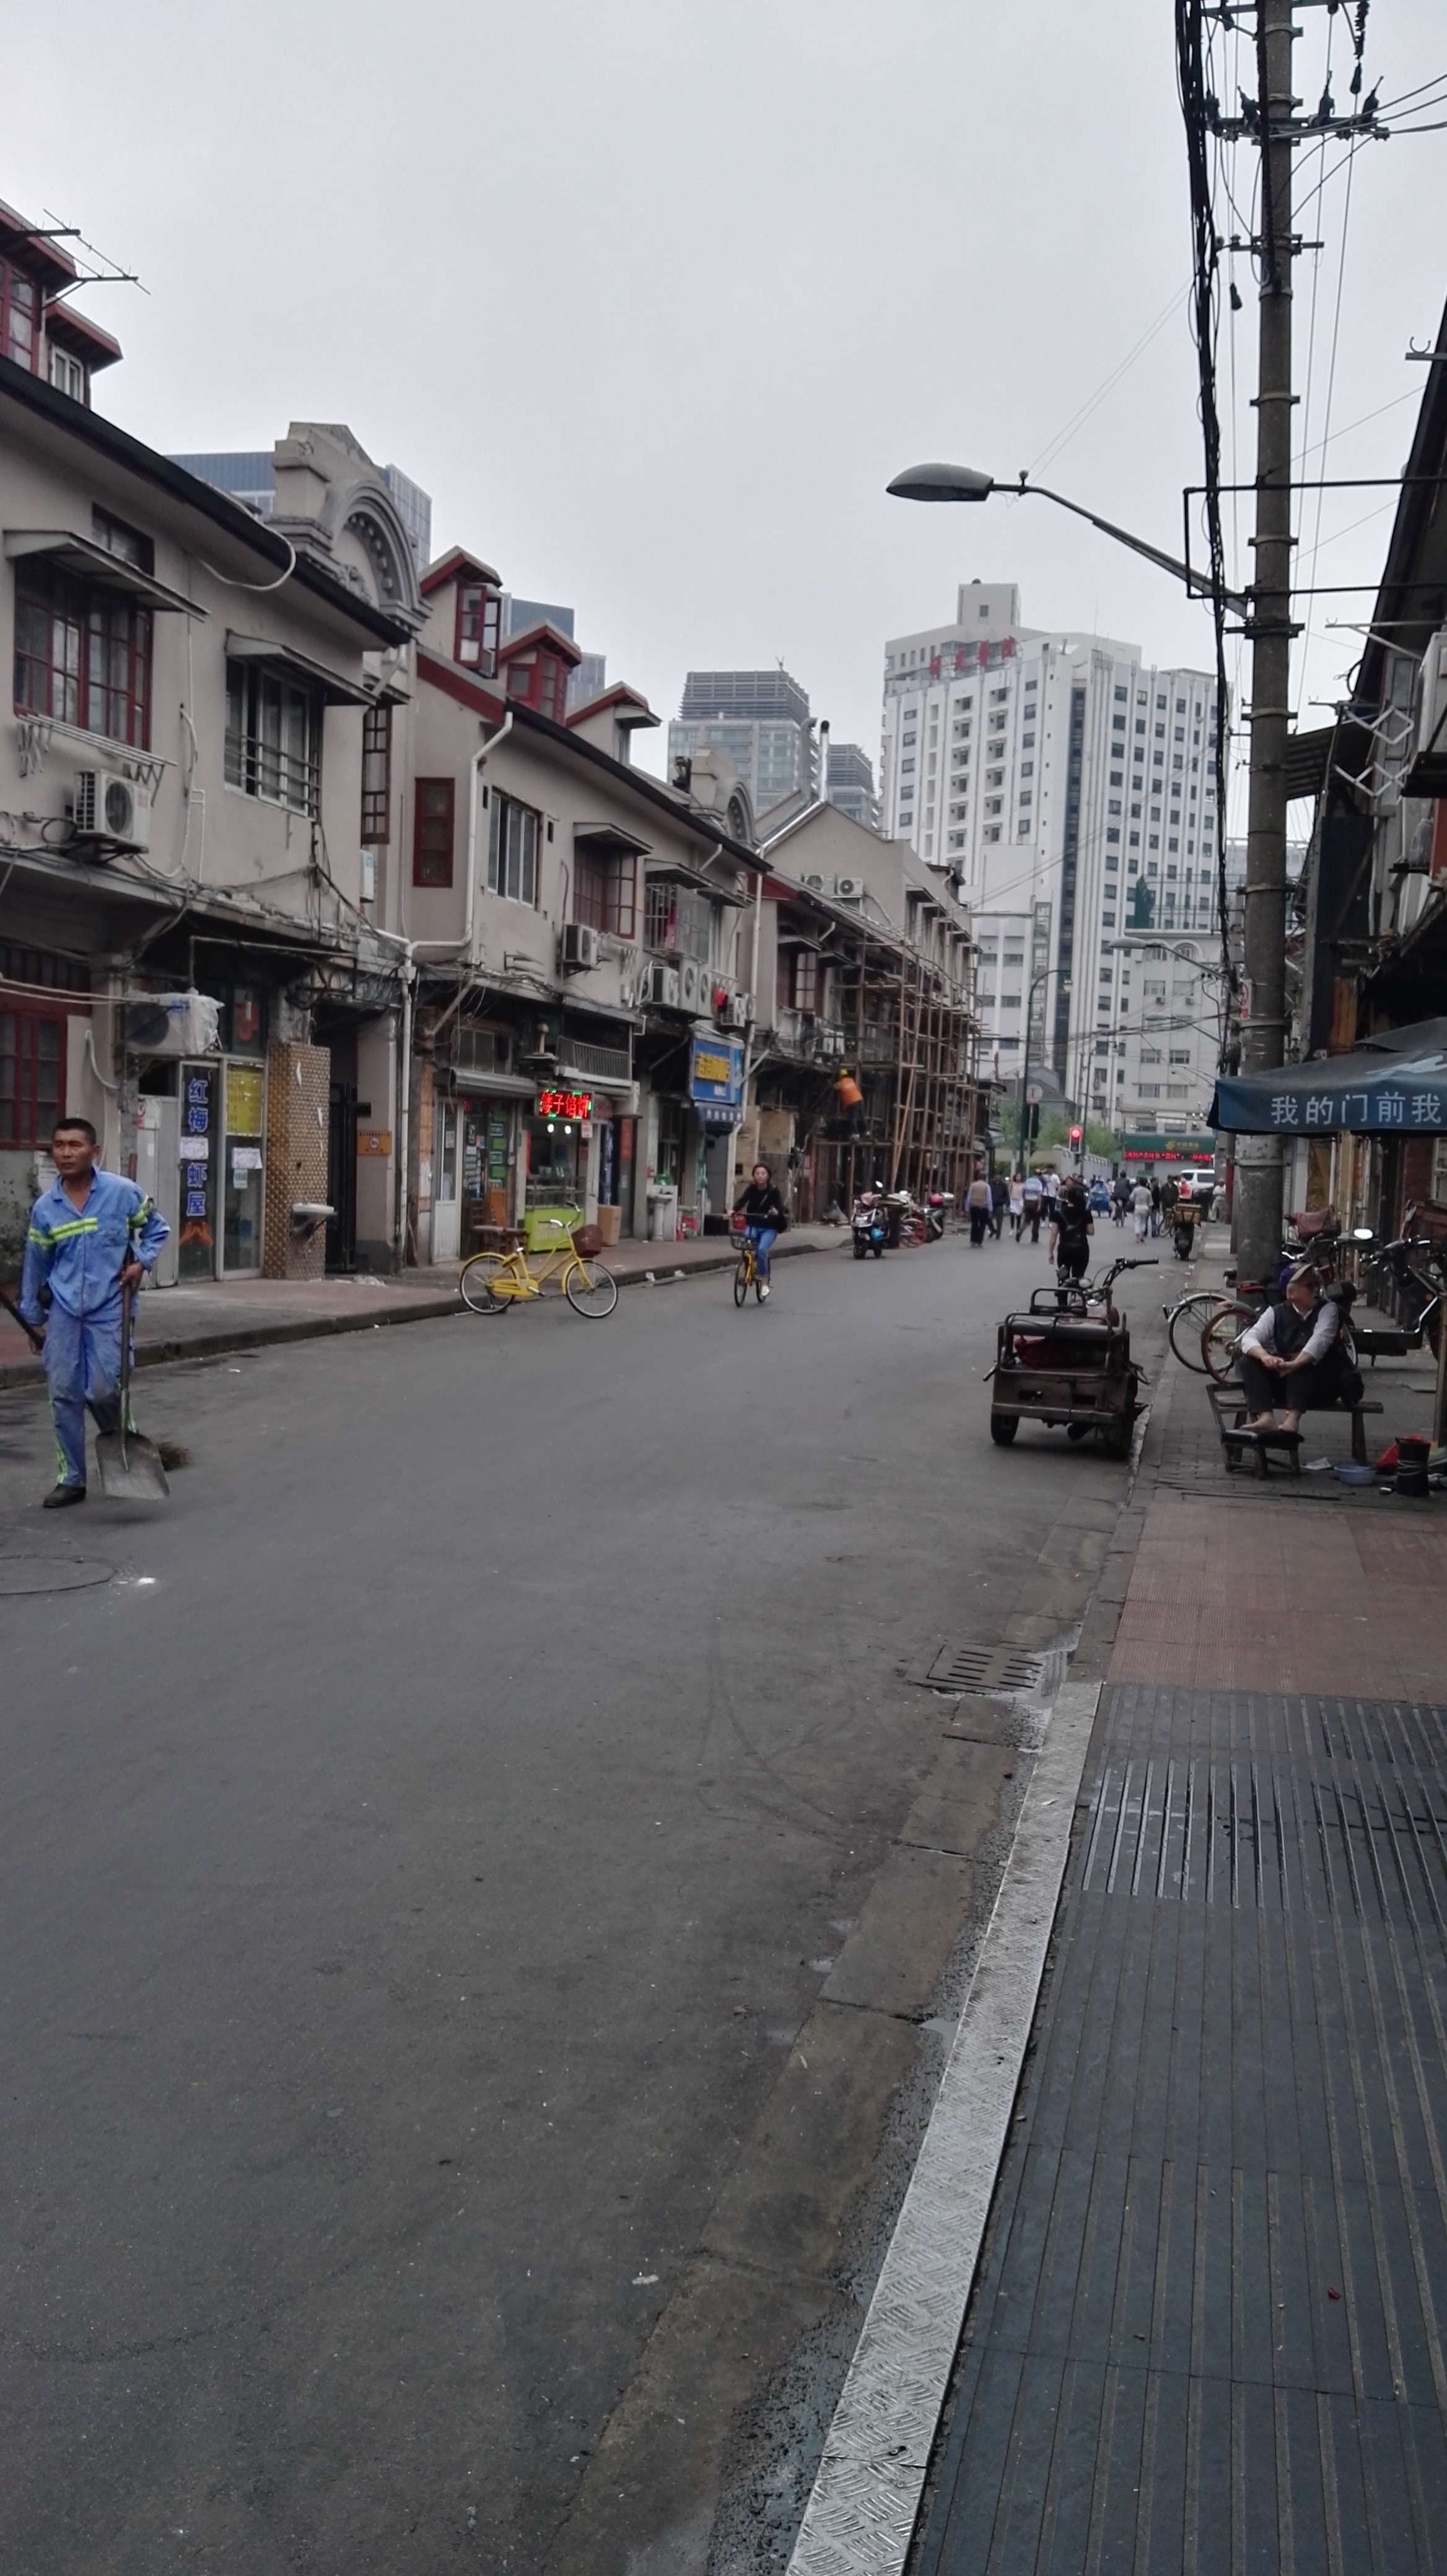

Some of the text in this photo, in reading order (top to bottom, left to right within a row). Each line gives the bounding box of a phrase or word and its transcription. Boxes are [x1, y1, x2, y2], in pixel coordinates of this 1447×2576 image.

[186, 1078, 208, 1216] 红梅虾屋
[1270, 1091, 1442, 1125] 我的门前我
